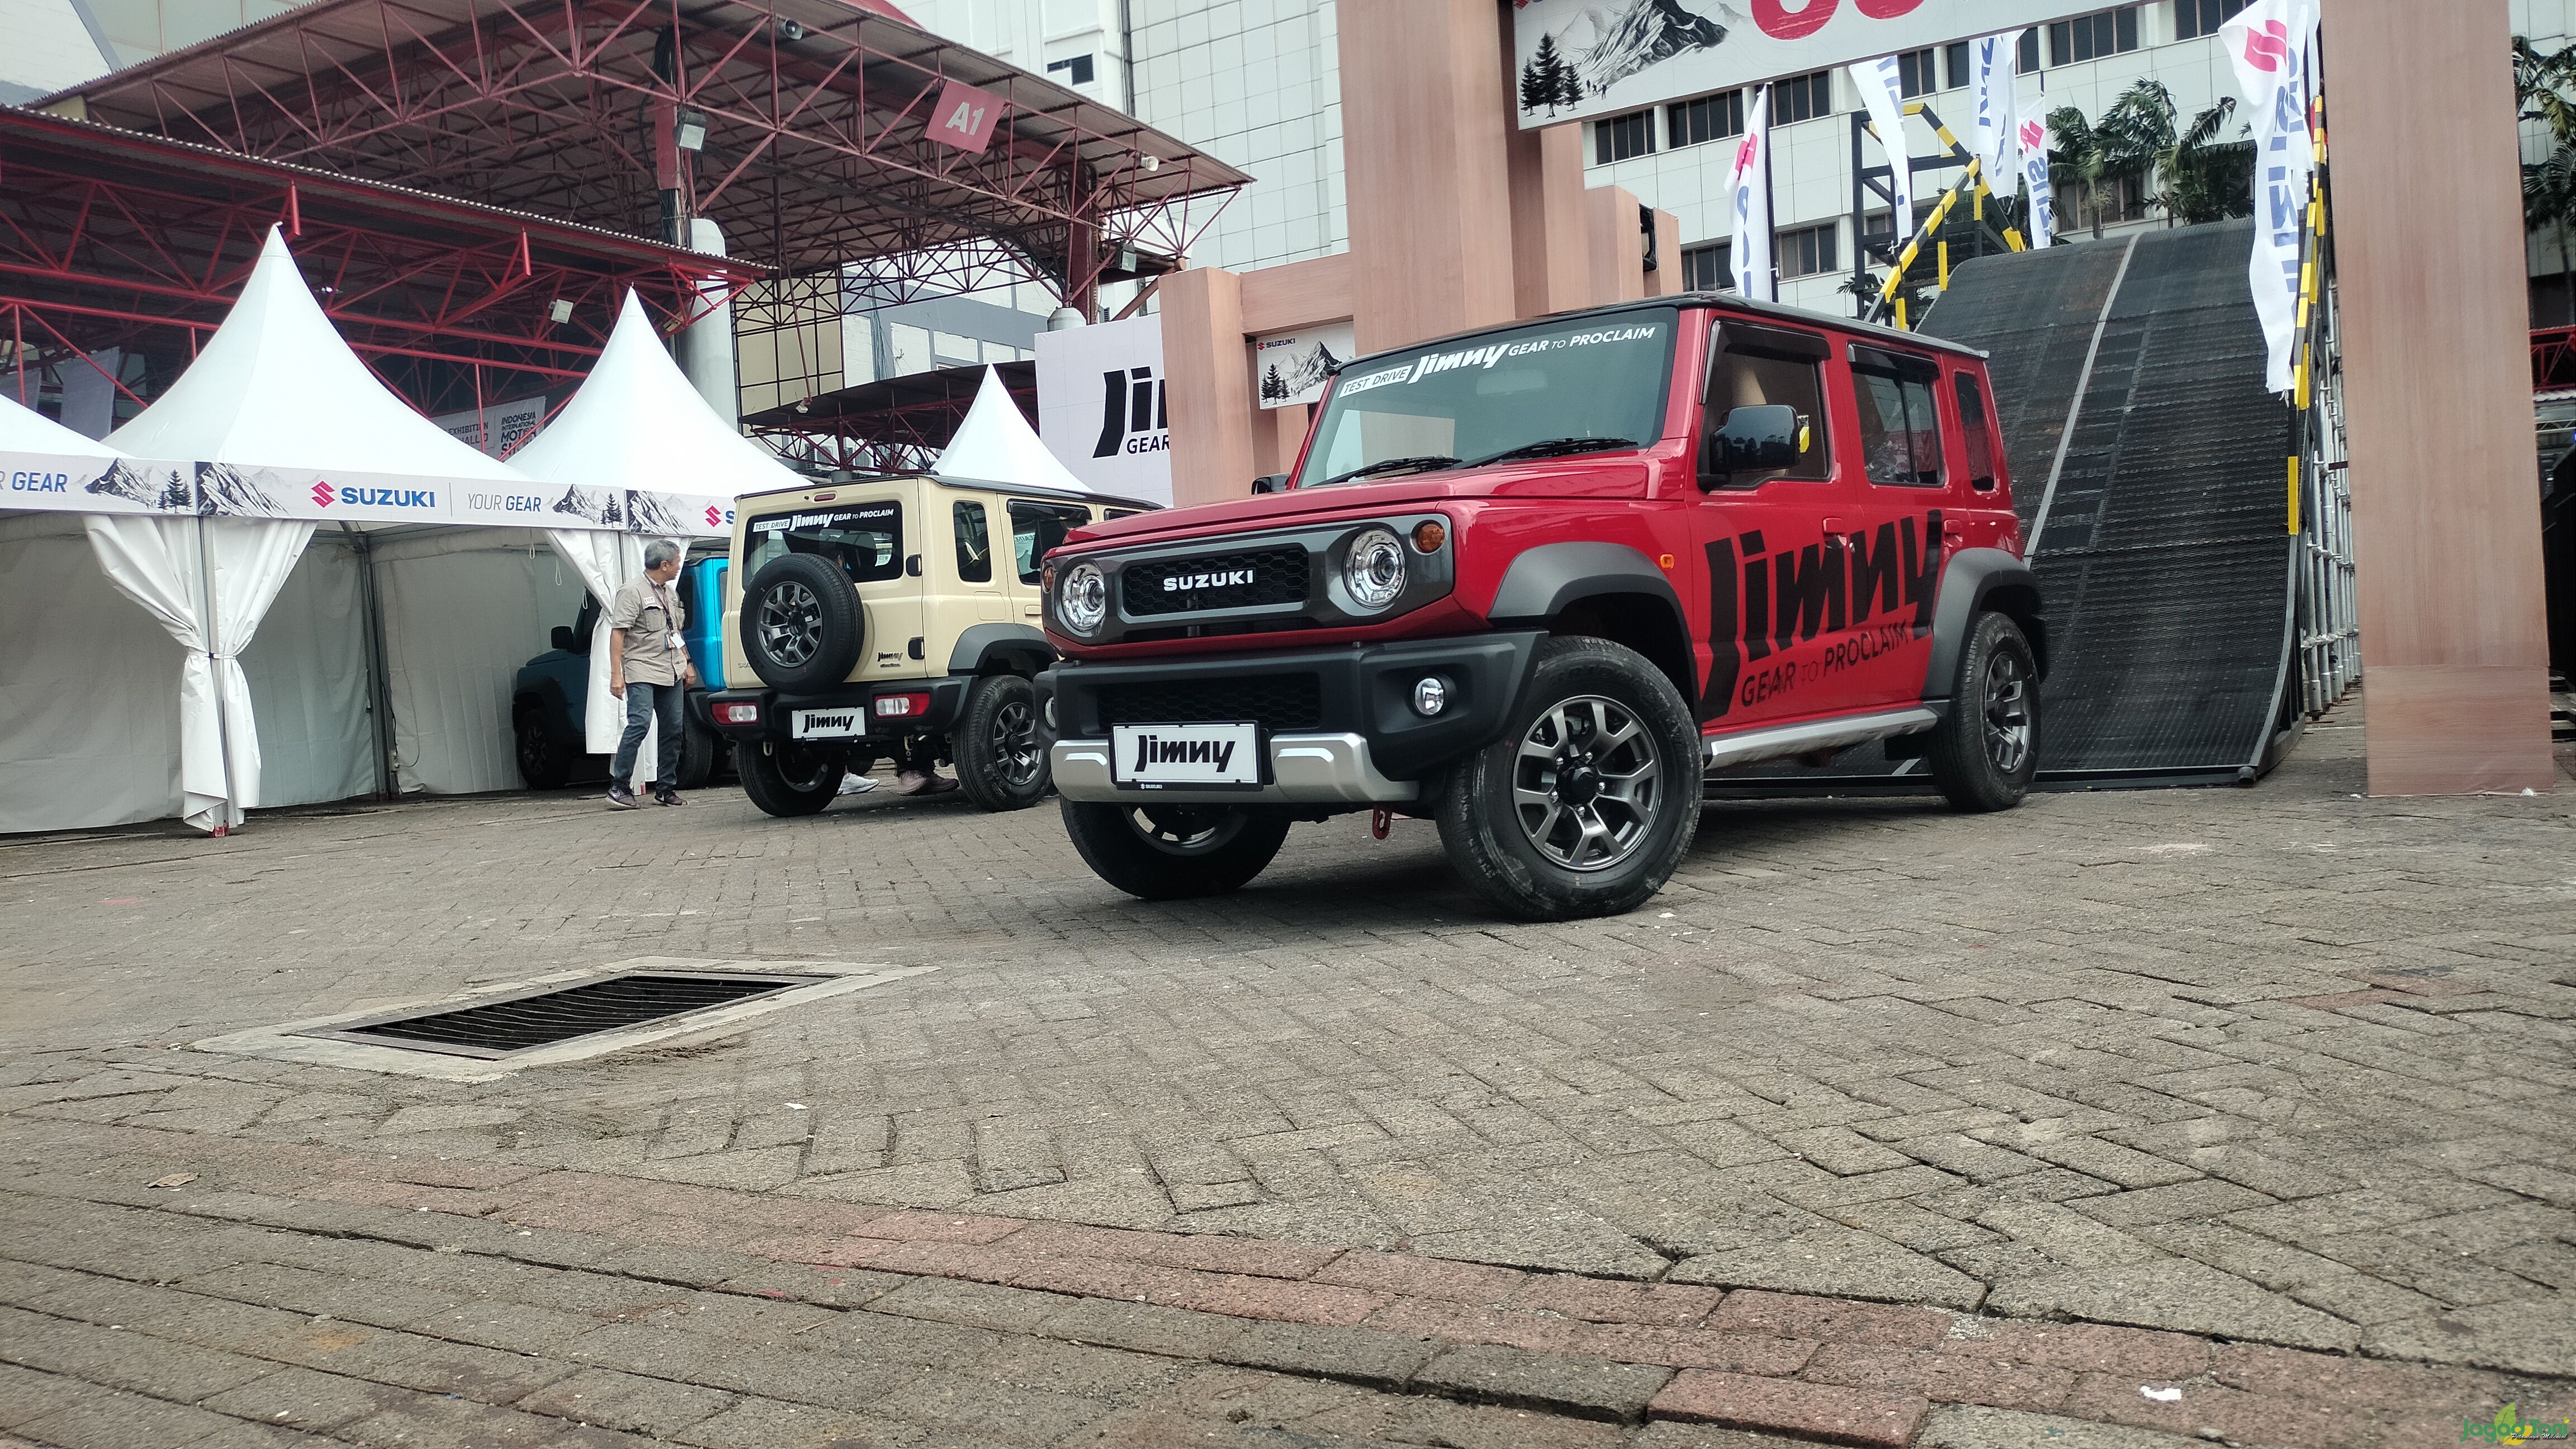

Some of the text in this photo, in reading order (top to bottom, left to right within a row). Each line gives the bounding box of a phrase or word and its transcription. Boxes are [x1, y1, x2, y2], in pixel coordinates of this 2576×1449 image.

[945, 102, 984, 135] A1
[1266, 338, 1295, 348] SUZUKI
[1344, 327, 1656, 394] TEST DRIVE Jimny GEAR TO PROCLAIM
[501, 411, 536, 425] INDONESIA
[12, 471, 68, 493] GEAR
[341, 487, 541, 512] SUZUKI YOUR GEAR
[789, 514, 834, 531] Jimny
[859, 509, 894, 518] PROCLAIM
[1163, 570, 1253, 591] SUZUKI
[1699, 509, 1942, 724] Jimny
[1741, 662, 1796, 707] GEAR
[1824, 618, 1909, 677] PROCLAIM
[803, 714, 855, 733] Jimny
[1134, 735, 1236, 773] Jimny
